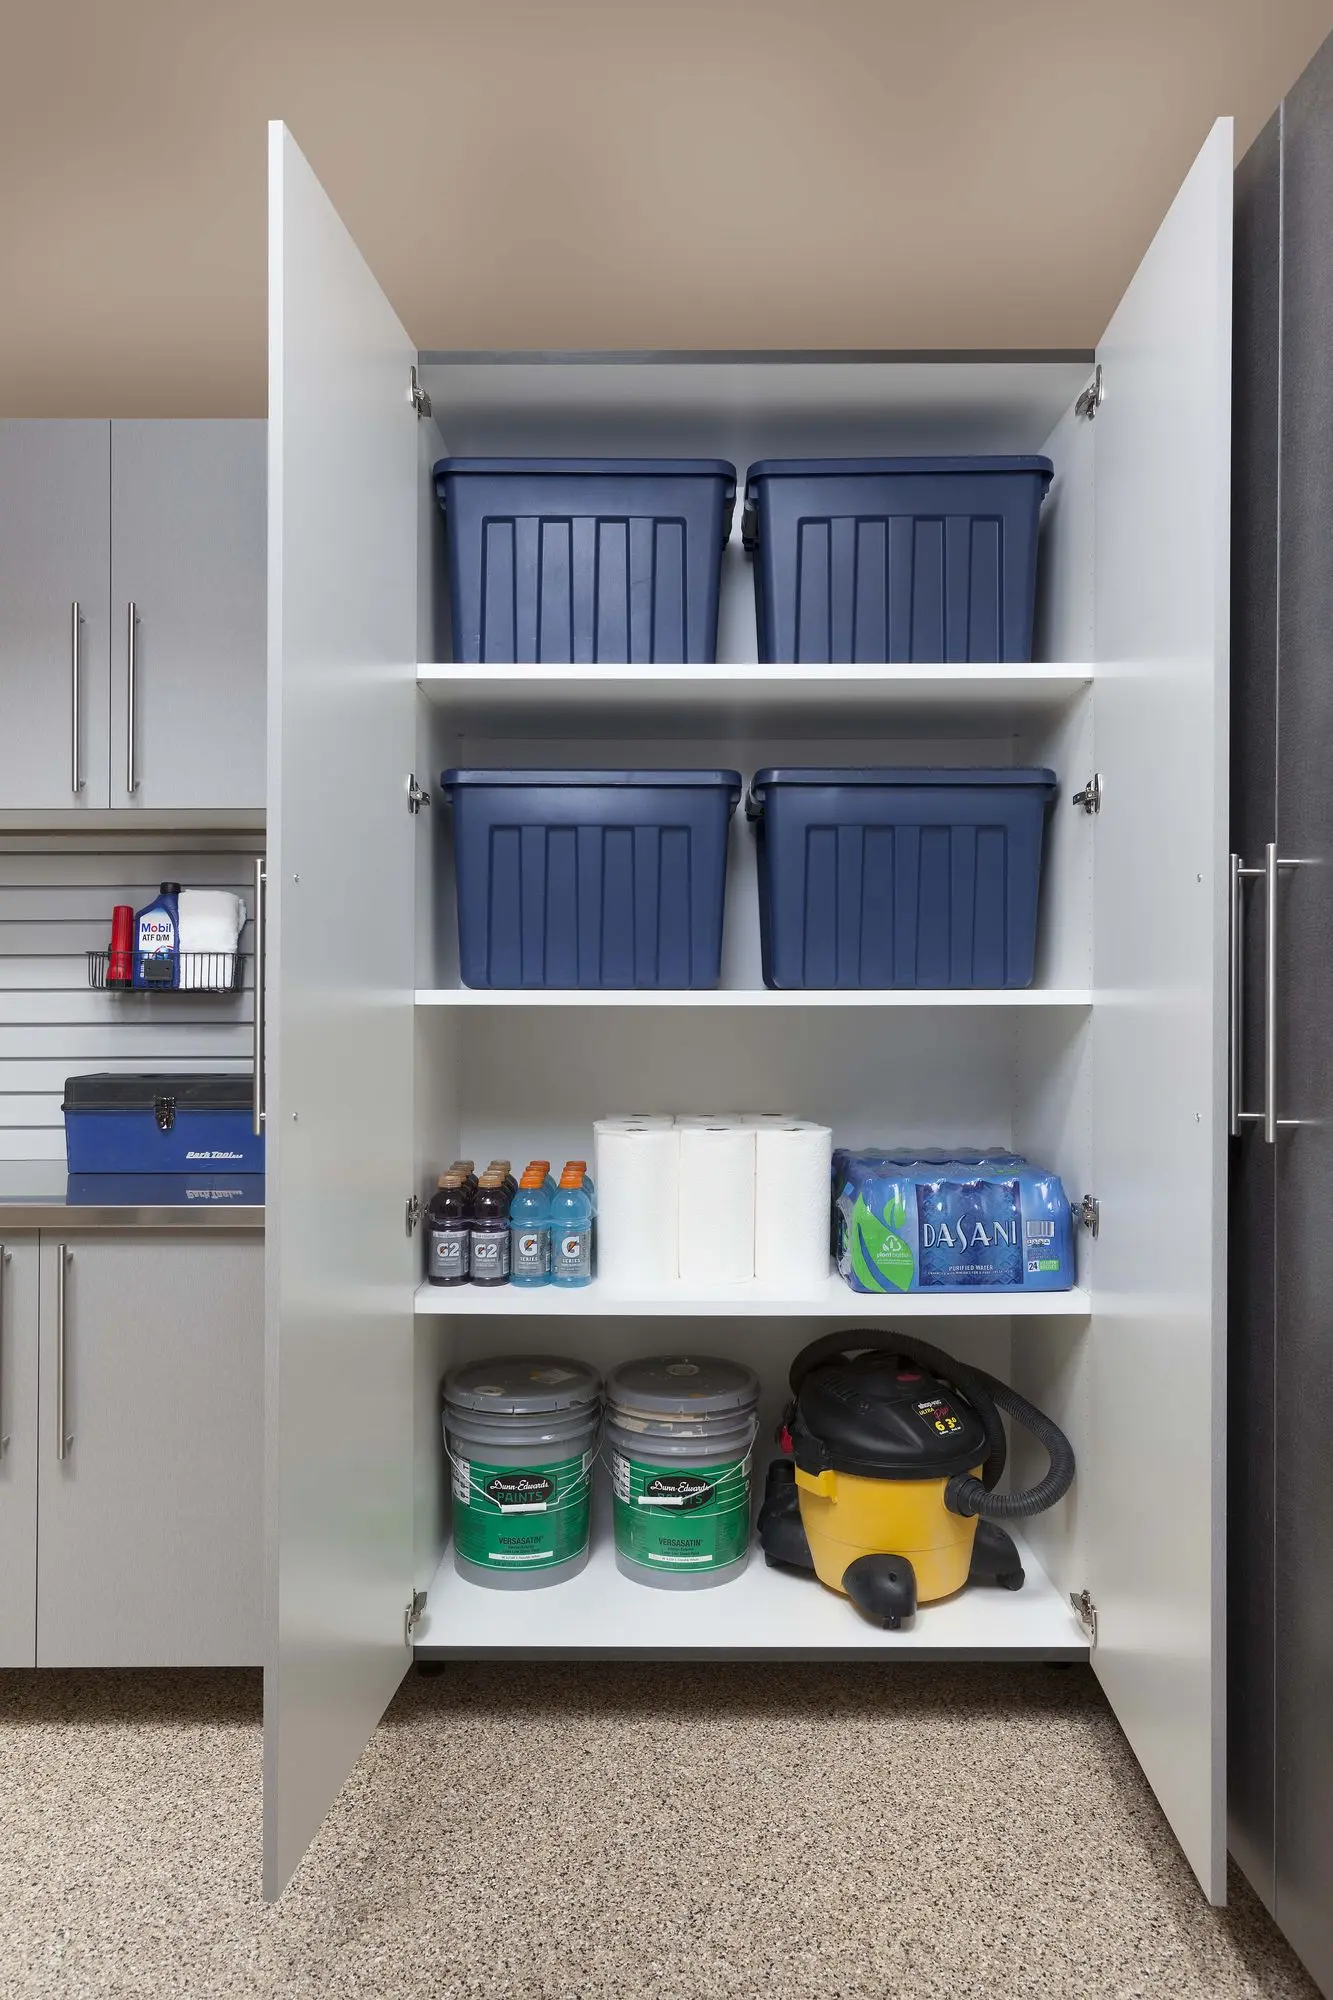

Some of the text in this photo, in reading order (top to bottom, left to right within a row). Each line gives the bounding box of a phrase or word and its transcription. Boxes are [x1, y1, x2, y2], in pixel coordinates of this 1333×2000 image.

[141, 922, 172, 933] Mobil
[142, 933, 155, 942] ATF
[185, 1151, 211, 1159] Park
[923, 1214, 1017, 1254] DASANI
[437, 1243, 460, 1257] G2
[474, 1243, 498, 1258] G2
[948, 1264, 975, 1272] PURIFIED
[1028, 1262, 1039, 1271] 24
[935, 1420, 946, 1431] 6
[489, 1479, 550, 1491] Dunn-Edwards
[497, 1491, 543, 1502] PAINTS
[658, 1537, 704, 1547] VERSASATIN
